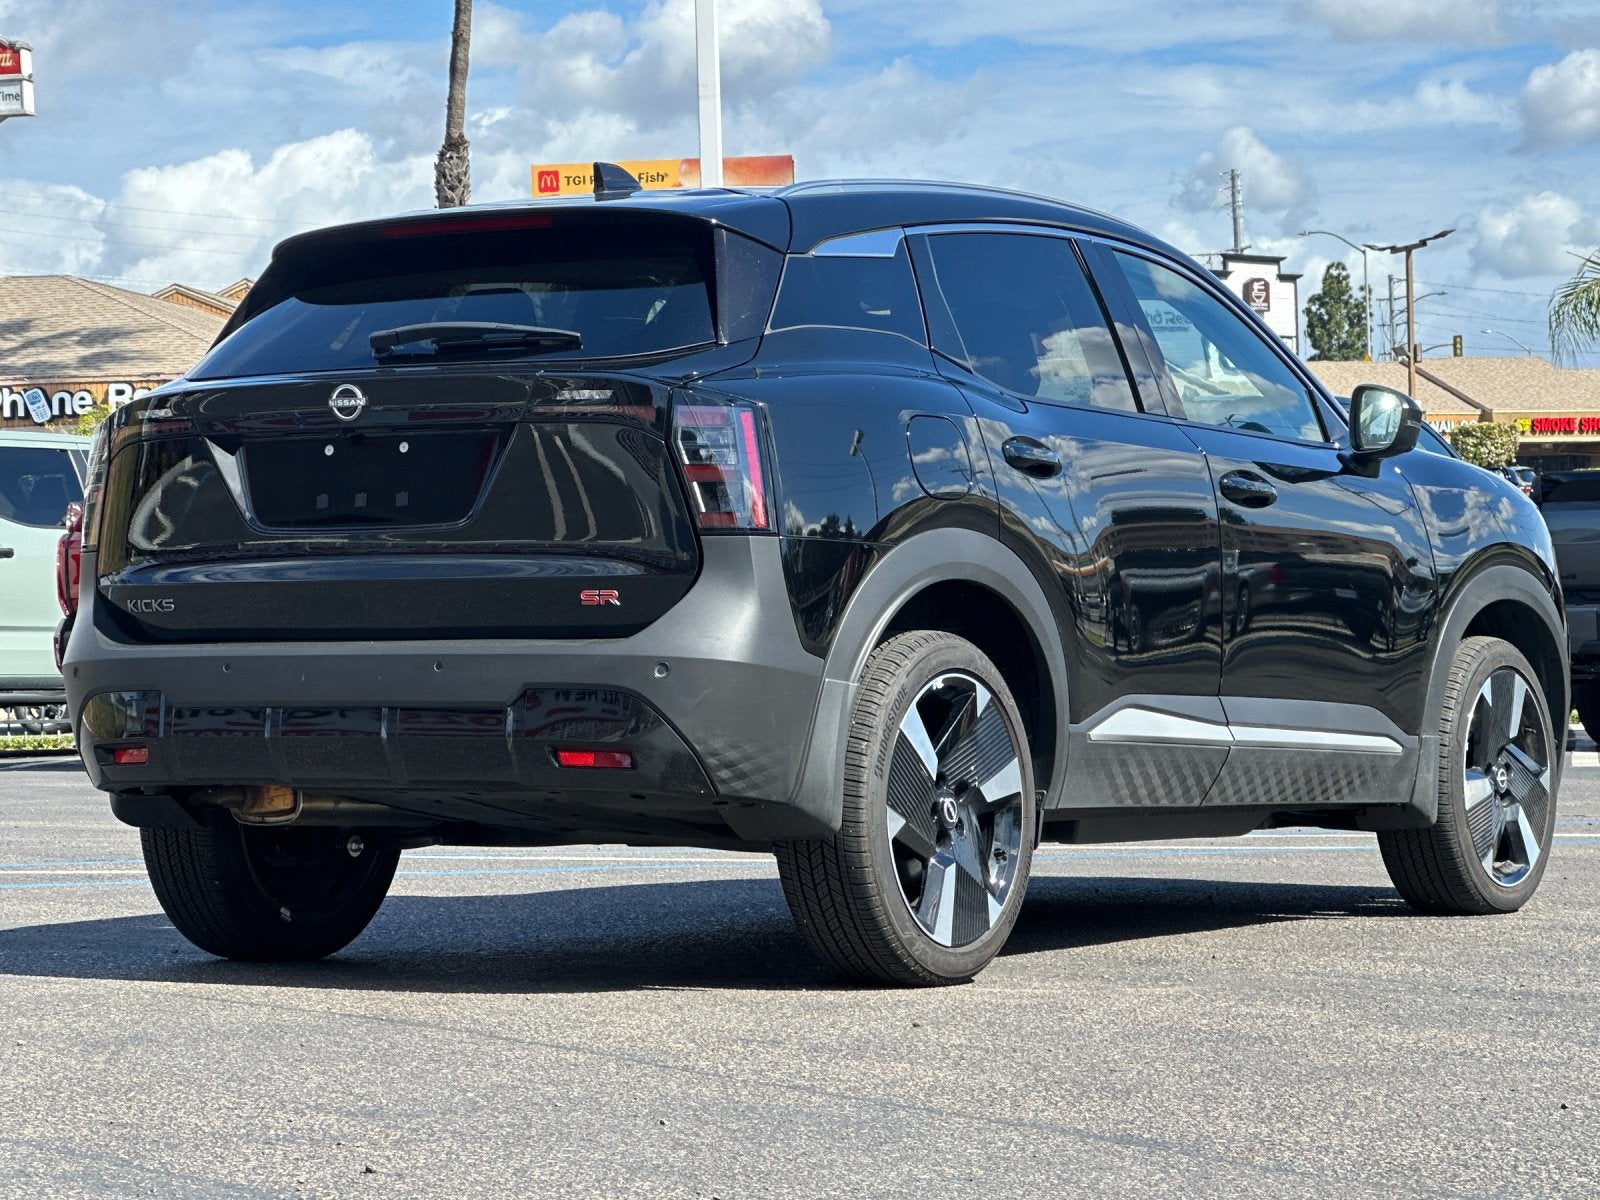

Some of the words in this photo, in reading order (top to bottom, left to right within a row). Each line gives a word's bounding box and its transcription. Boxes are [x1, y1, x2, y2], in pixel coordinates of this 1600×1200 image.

[0, 91, 20, 101] ime
[564, 175, 586, 186] TGI
[328, 398, 365, 407] NISSAN
[1533, 417, 1577, 431] SMOKE
[580, 590, 621, 606] SR
[127, 598, 175, 613] KICKS
[874, 683, 909, 780] BRIDGESTONE
